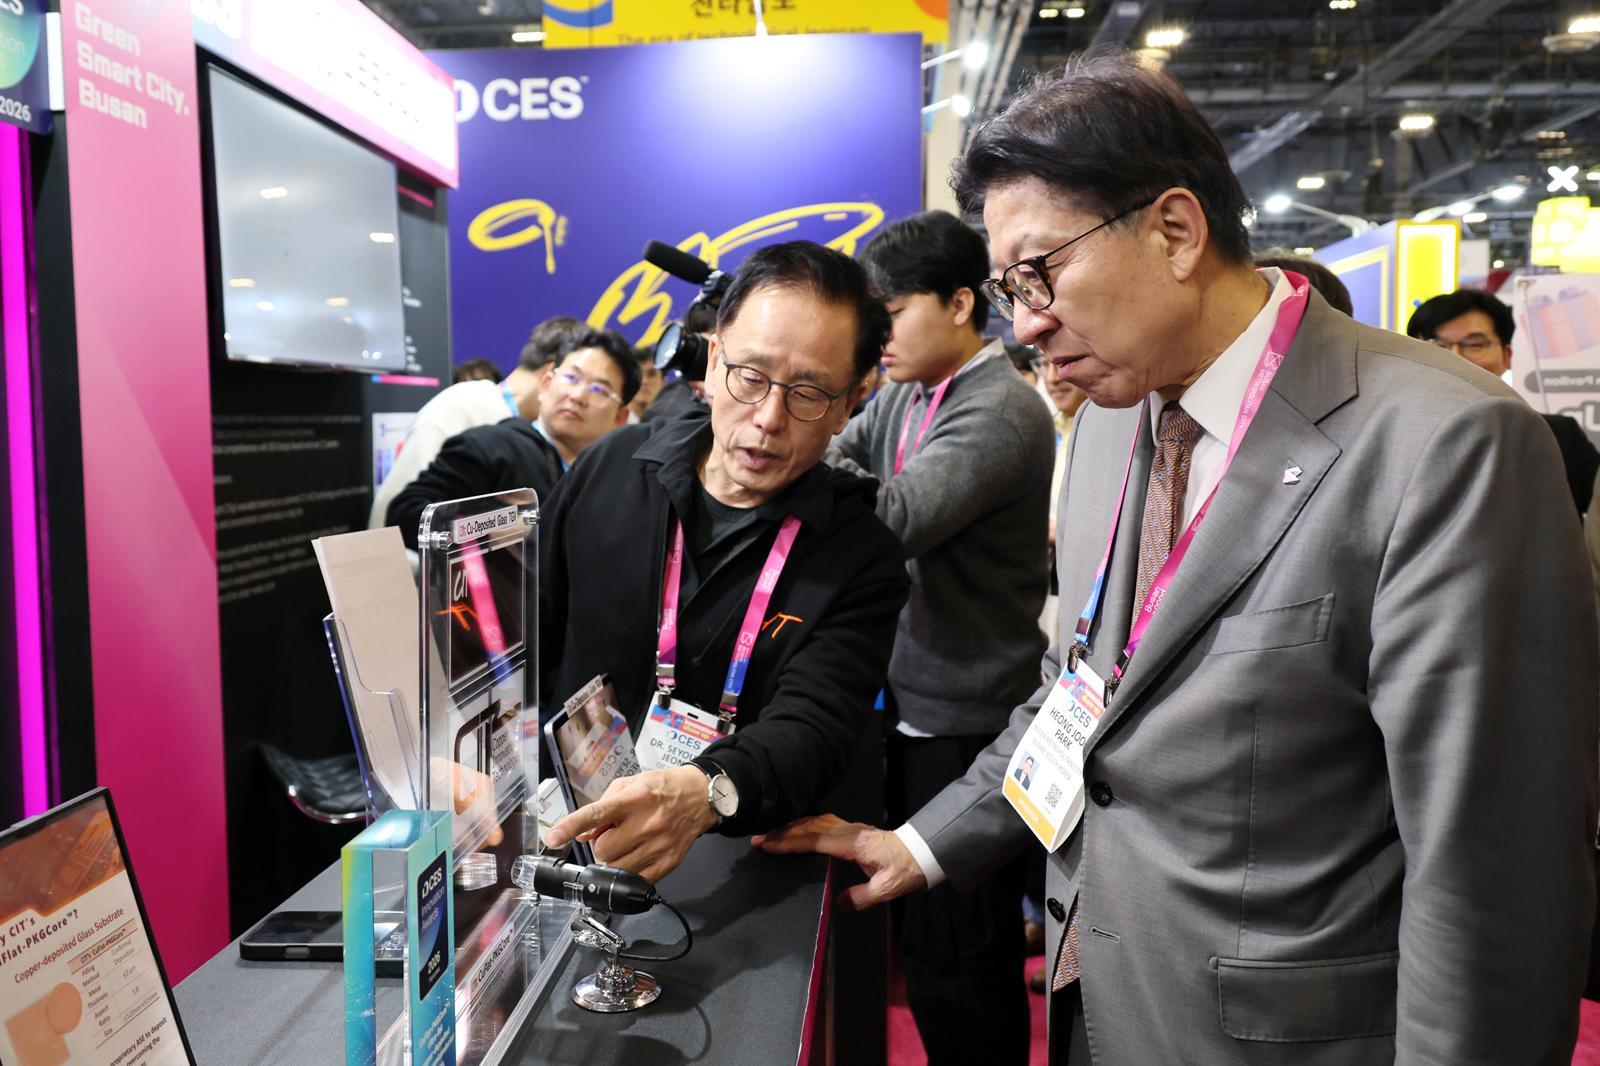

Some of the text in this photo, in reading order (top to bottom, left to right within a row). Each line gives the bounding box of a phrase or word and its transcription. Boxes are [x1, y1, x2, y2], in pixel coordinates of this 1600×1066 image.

[75, 2, 140, 56] Green
[77, 40, 190, 116] Smart City,
[0, 95, 31, 122] 2026
[78, 78, 147, 128] Busan
[482, 76, 584, 121] CES
[1144, 586, 1161, 613] Busan
[1050, 707, 1087, 747] HEONG JOO
[1073, 706, 1091, 728] CES
[650, 738, 664, 750] DR.
[678, 734, 701, 750] CES
[1055, 729, 1073, 750] PARK
[429, 867, 442, 890] CES
[9, 917, 35, 937] CIT's
[15, 908, 124, 984] Copper-deposited Glass Substrate
[428, 951, 441, 975] 2026
[145, 1031, 151, 1039] to
[150, 1017, 167, 1034] deposit
[152, 1036, 160, 1046] the
